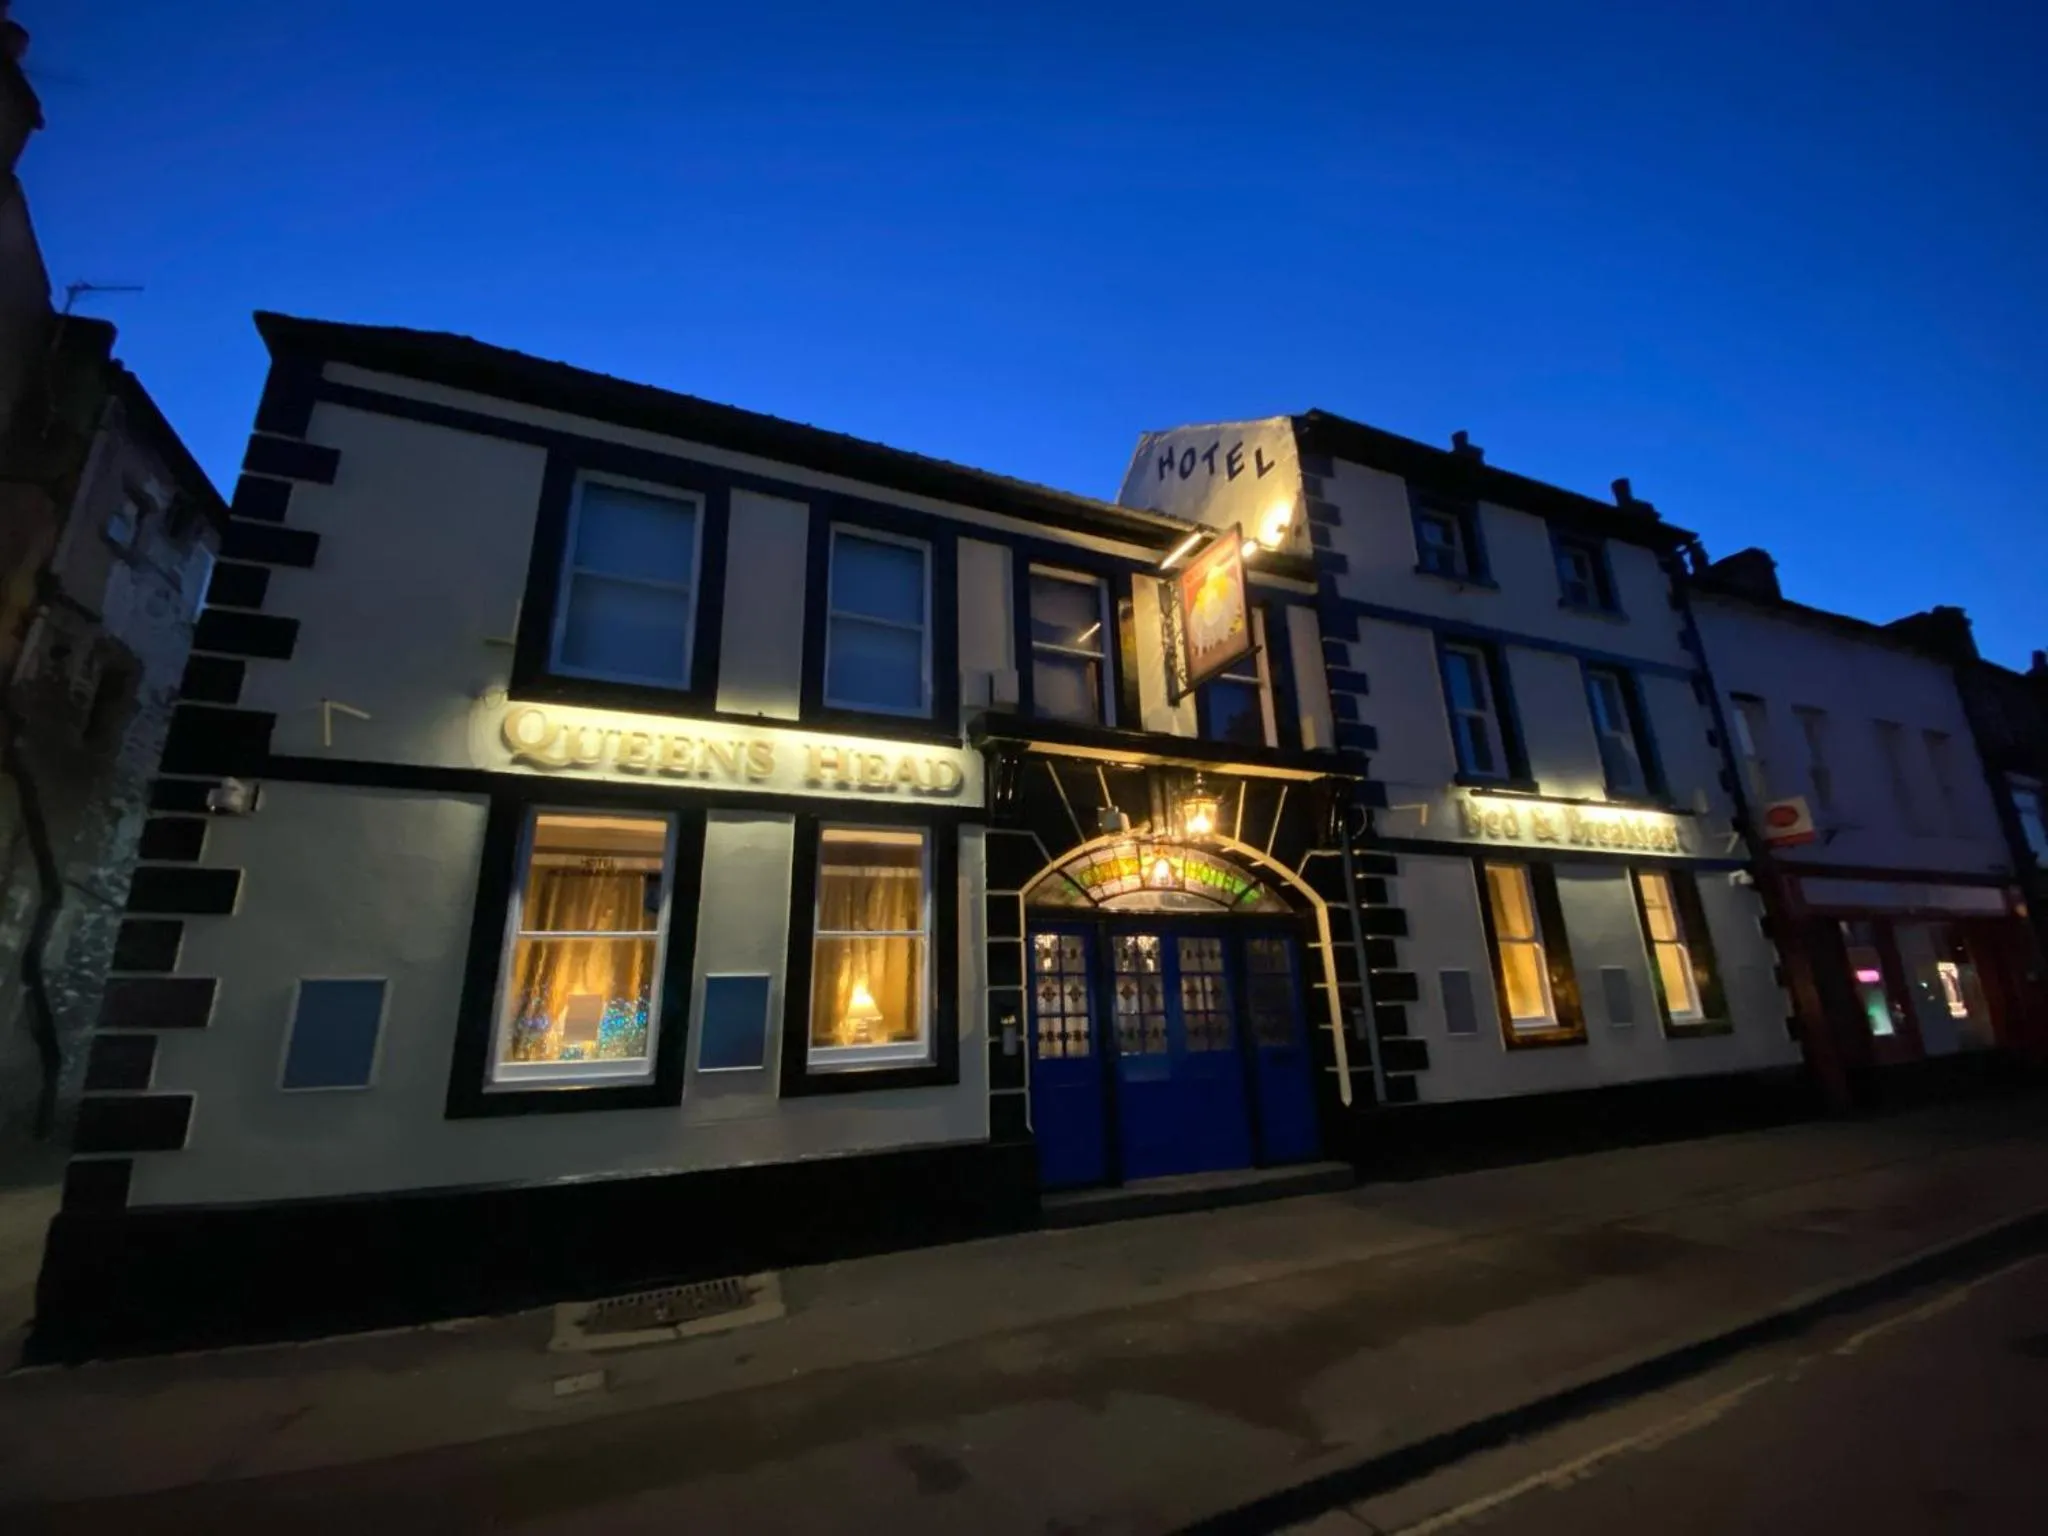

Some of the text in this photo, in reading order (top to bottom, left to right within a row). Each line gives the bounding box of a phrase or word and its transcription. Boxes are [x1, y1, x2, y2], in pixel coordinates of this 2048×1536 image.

[1158, 441, 1275, 481] HOTEL
[500, 705, 965, 798] QUEENS HEAD
[1530, 805, 1560, 844] &
